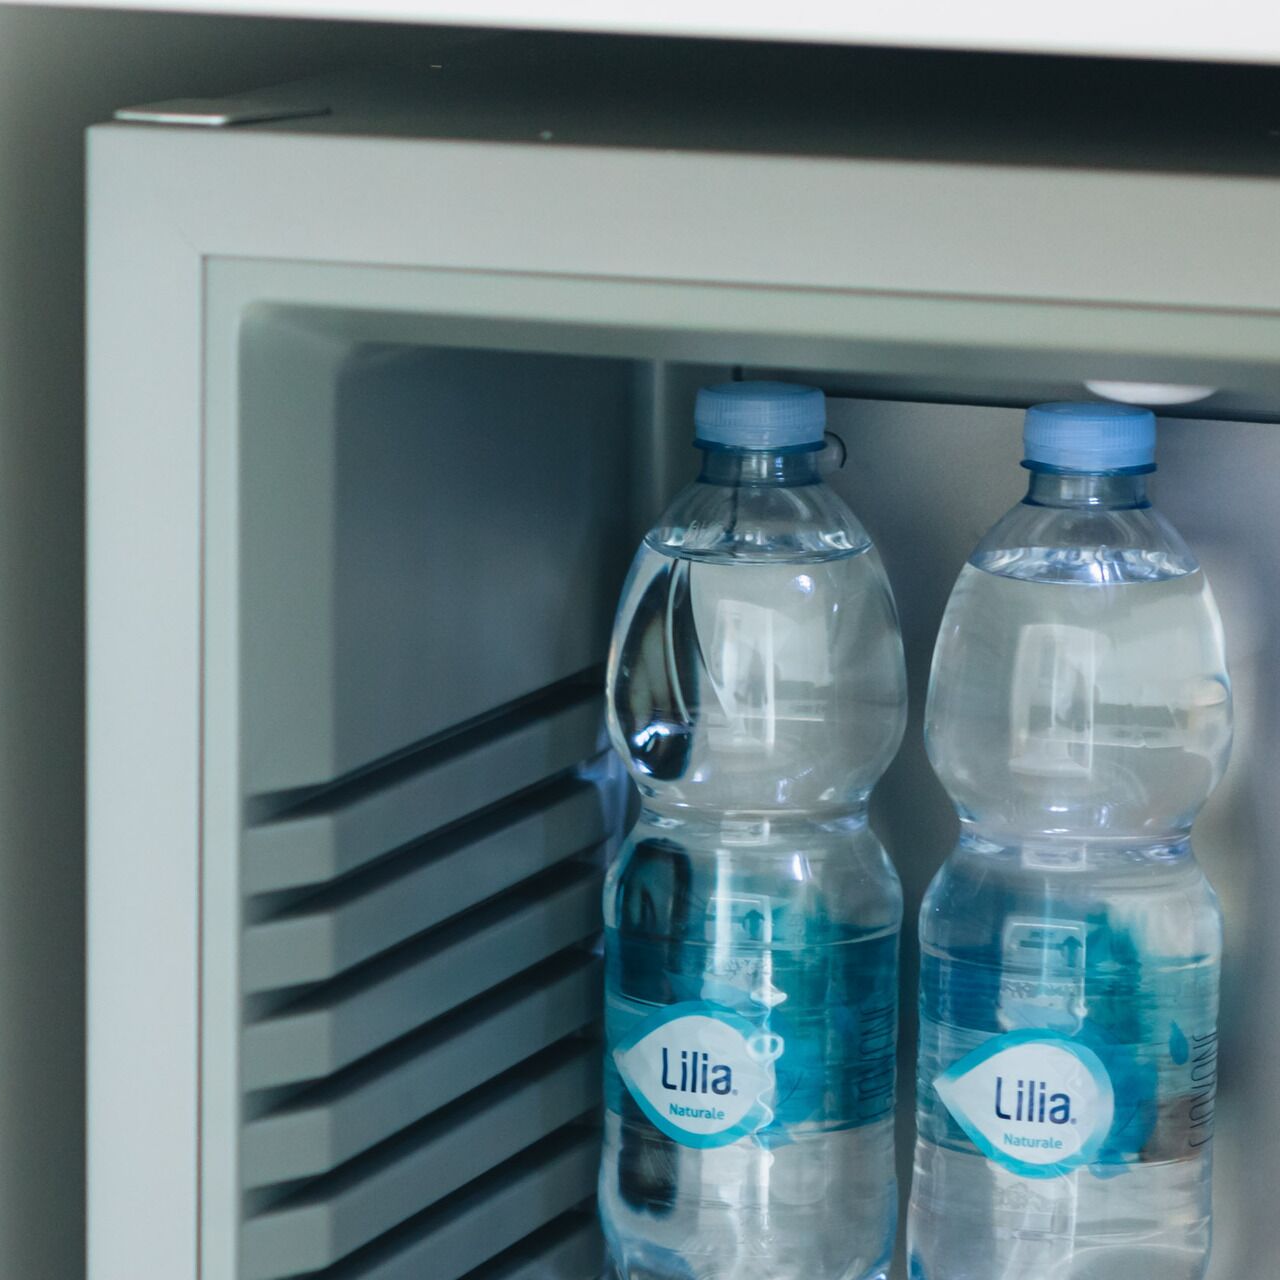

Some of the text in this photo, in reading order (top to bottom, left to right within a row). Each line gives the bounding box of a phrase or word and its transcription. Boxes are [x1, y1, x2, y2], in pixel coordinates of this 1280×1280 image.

[662, 1047, 733, 1096] Lilia
[670, 1102, 725, 1120] Naturale
[995, 1076, 1072, 1125] Lilia
[1003, 1133, 1064, 1150] Naturale
